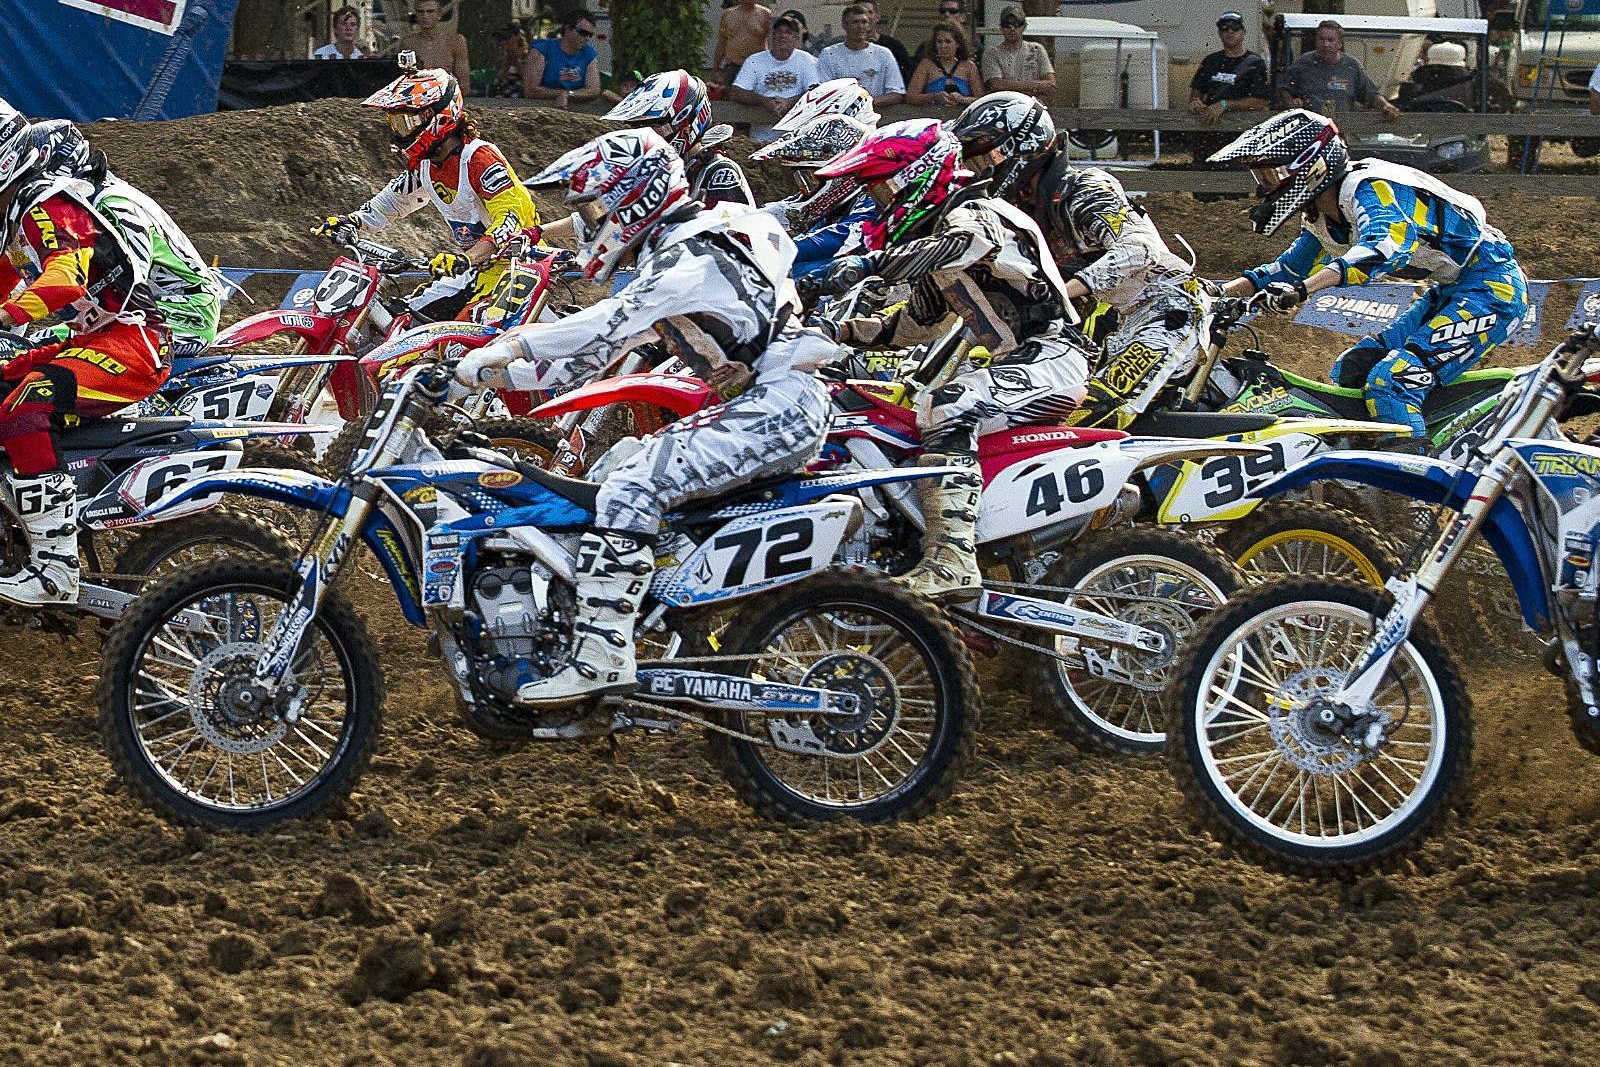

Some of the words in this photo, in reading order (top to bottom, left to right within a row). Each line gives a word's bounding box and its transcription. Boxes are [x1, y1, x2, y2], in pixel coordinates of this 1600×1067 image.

[316, 269, 371, 309] 37
[202, 380, 256, 421] 57
[1011, 430, 1080, 445] HONDA
[1025, 458, 1105, 518] 46
[1201, 441, 1286, 509] 39
[713, 517, 813, 589] 72
[683, 677, 751, 701] YAMAHA
